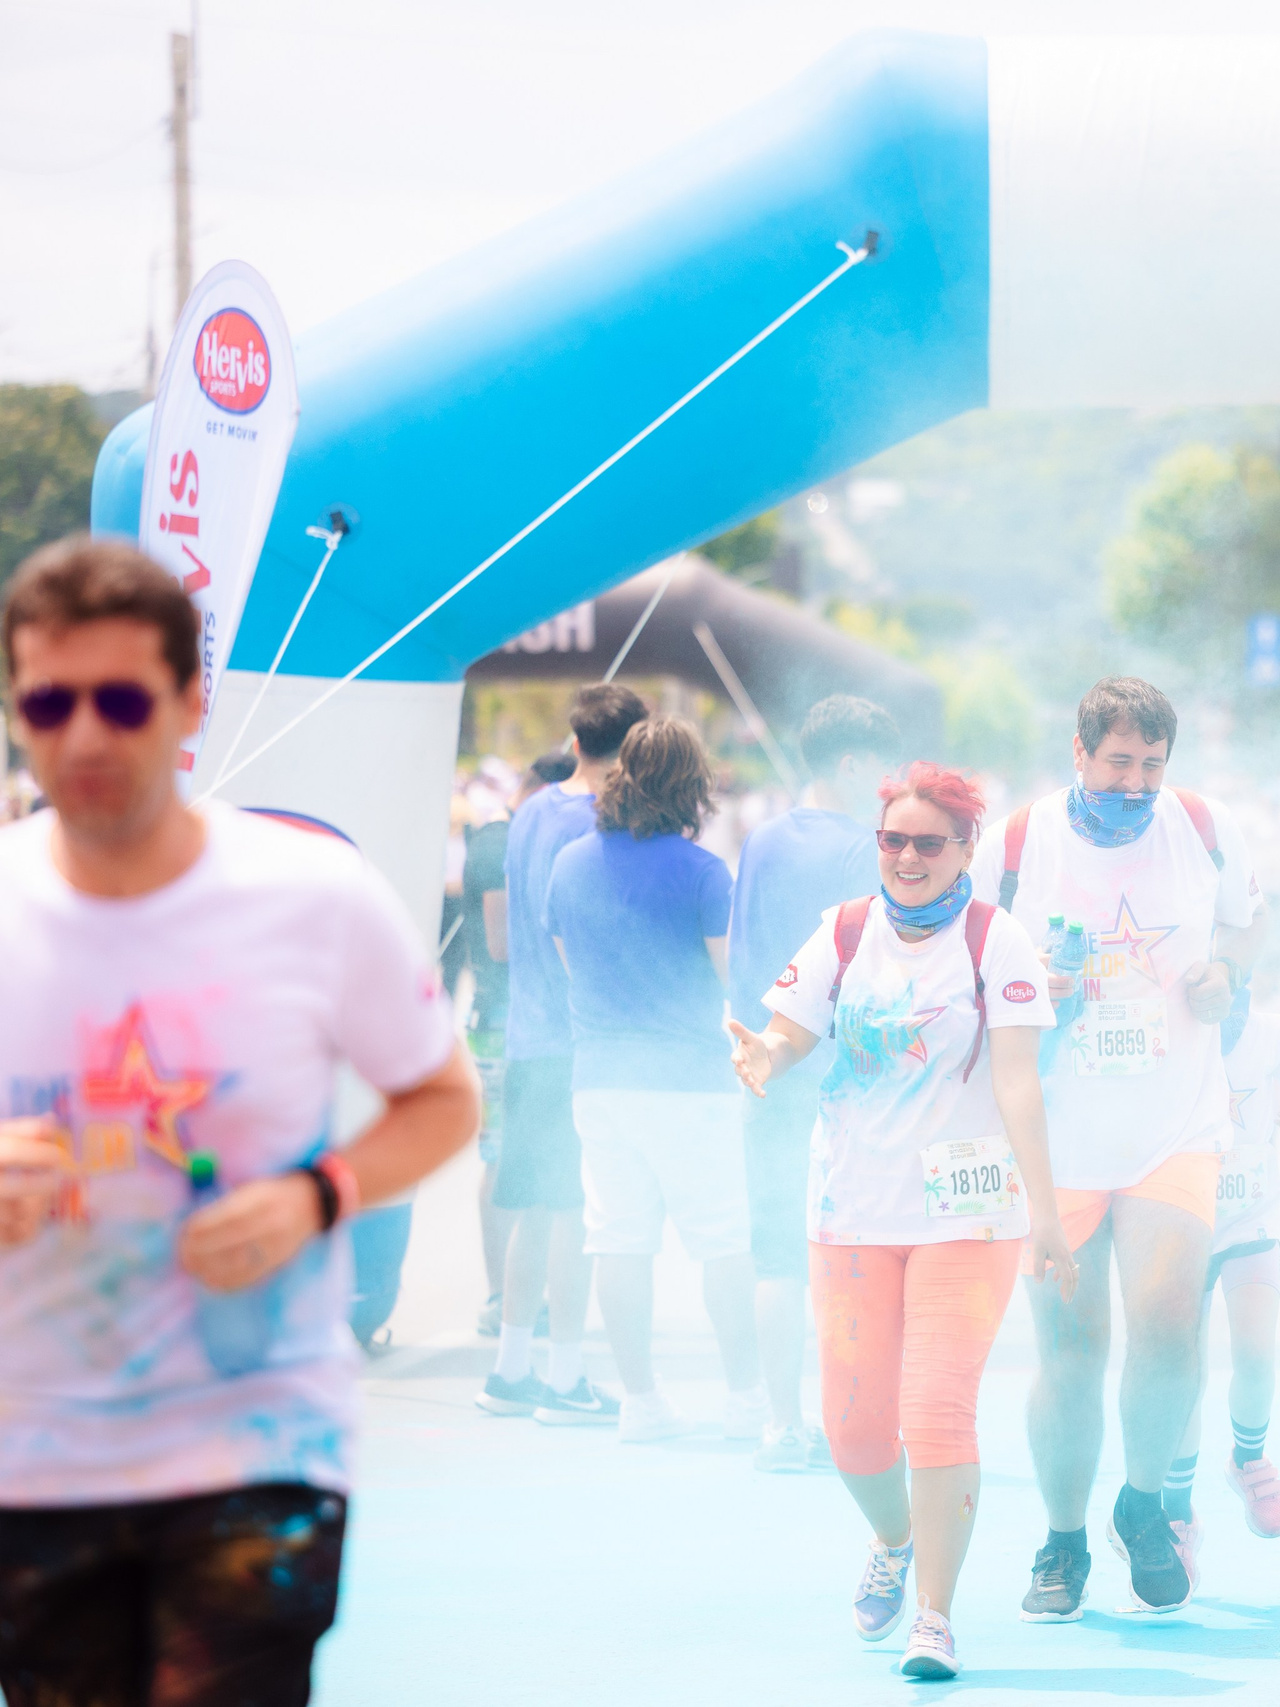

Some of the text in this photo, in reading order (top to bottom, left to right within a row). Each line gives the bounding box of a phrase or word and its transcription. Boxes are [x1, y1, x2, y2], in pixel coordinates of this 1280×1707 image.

[202, 330, 266, 394] Hervis
[209, 379, 237, 397] SPORTS
[206, 420, 224, 435] GET
[1006, 986, 1035, 998] Hervis
[1096, 1028, 1146, 1057] 15859
[950, 1164, 1001, 1195] 18120
